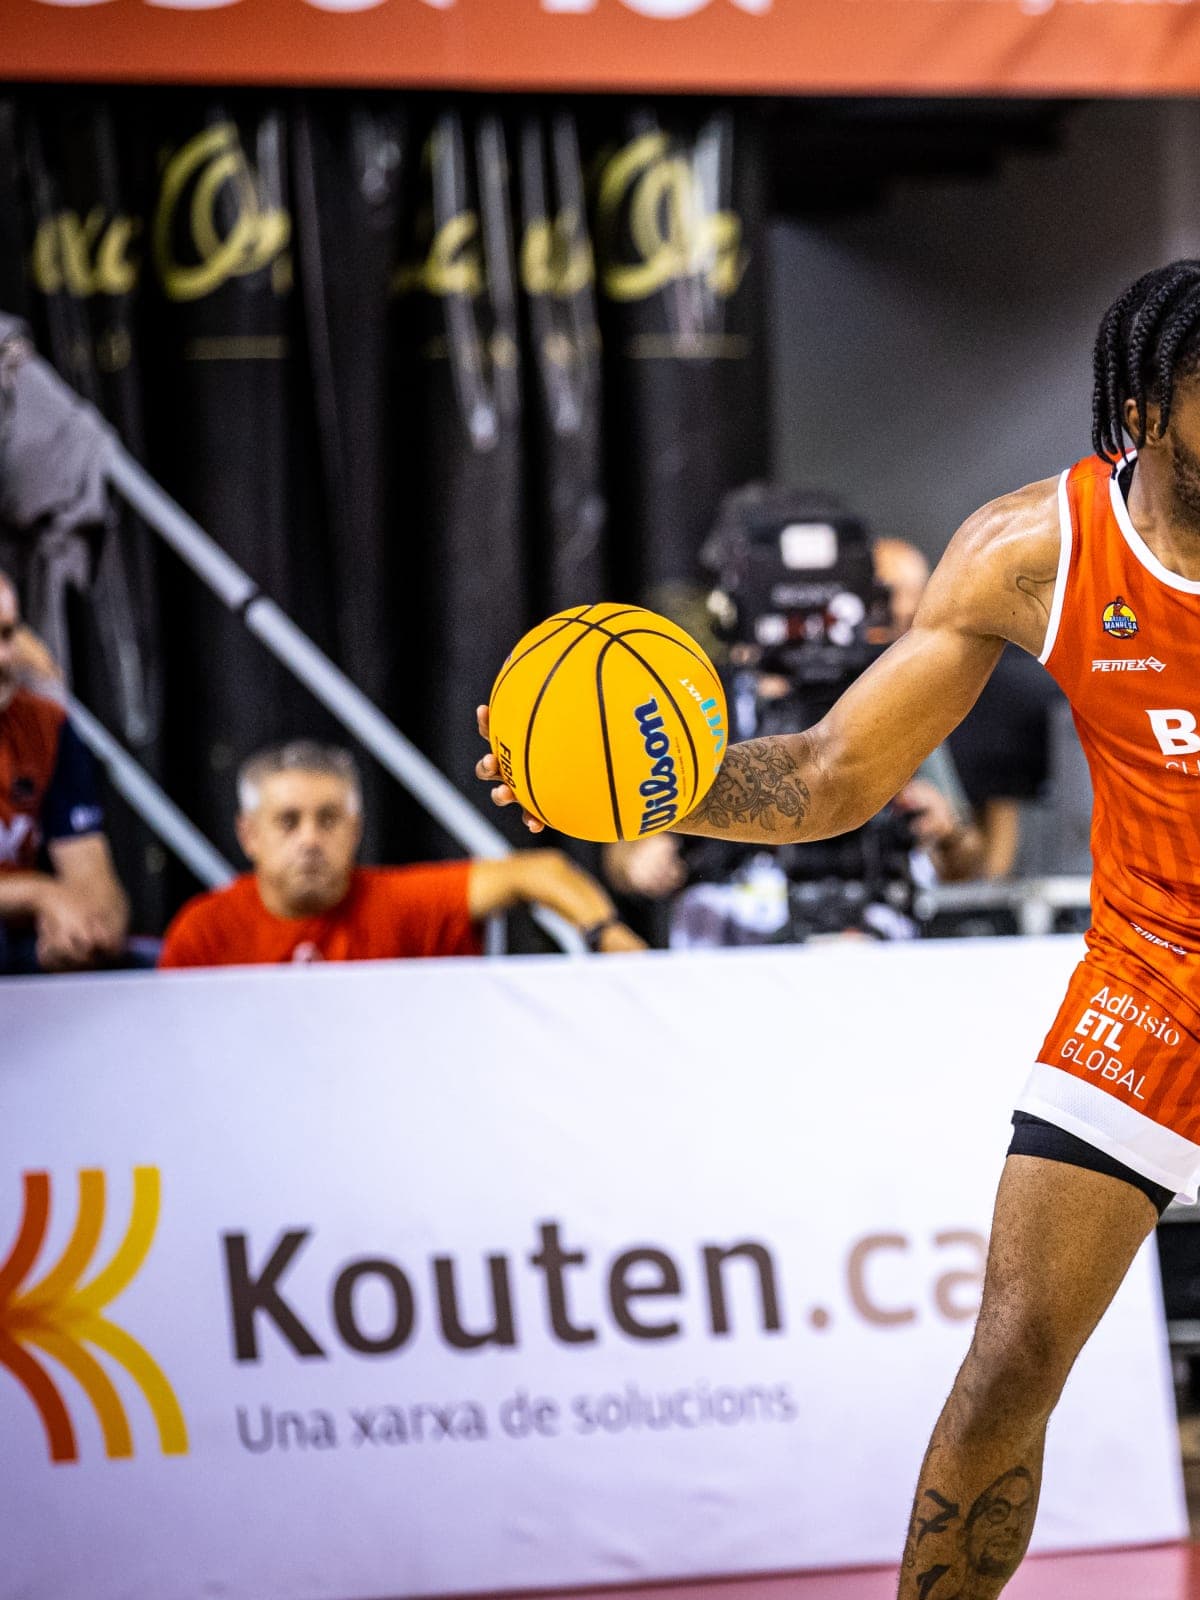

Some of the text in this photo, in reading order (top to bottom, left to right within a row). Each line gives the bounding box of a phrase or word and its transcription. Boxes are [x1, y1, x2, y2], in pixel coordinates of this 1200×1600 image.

[1092, 659, 1148, 672] PENTEX
[499, 741, 517, 789] FIBA
[634, 698, 678, 836] Wilson
[1074, 1008, 1124, 1053] ETL
[1090, 986, 1180, 1046] Adbisio
[1060, 1038, 1146, 1100] GLOBAL
[236, 1379, 798, 1454] Una xarxa de solucions
